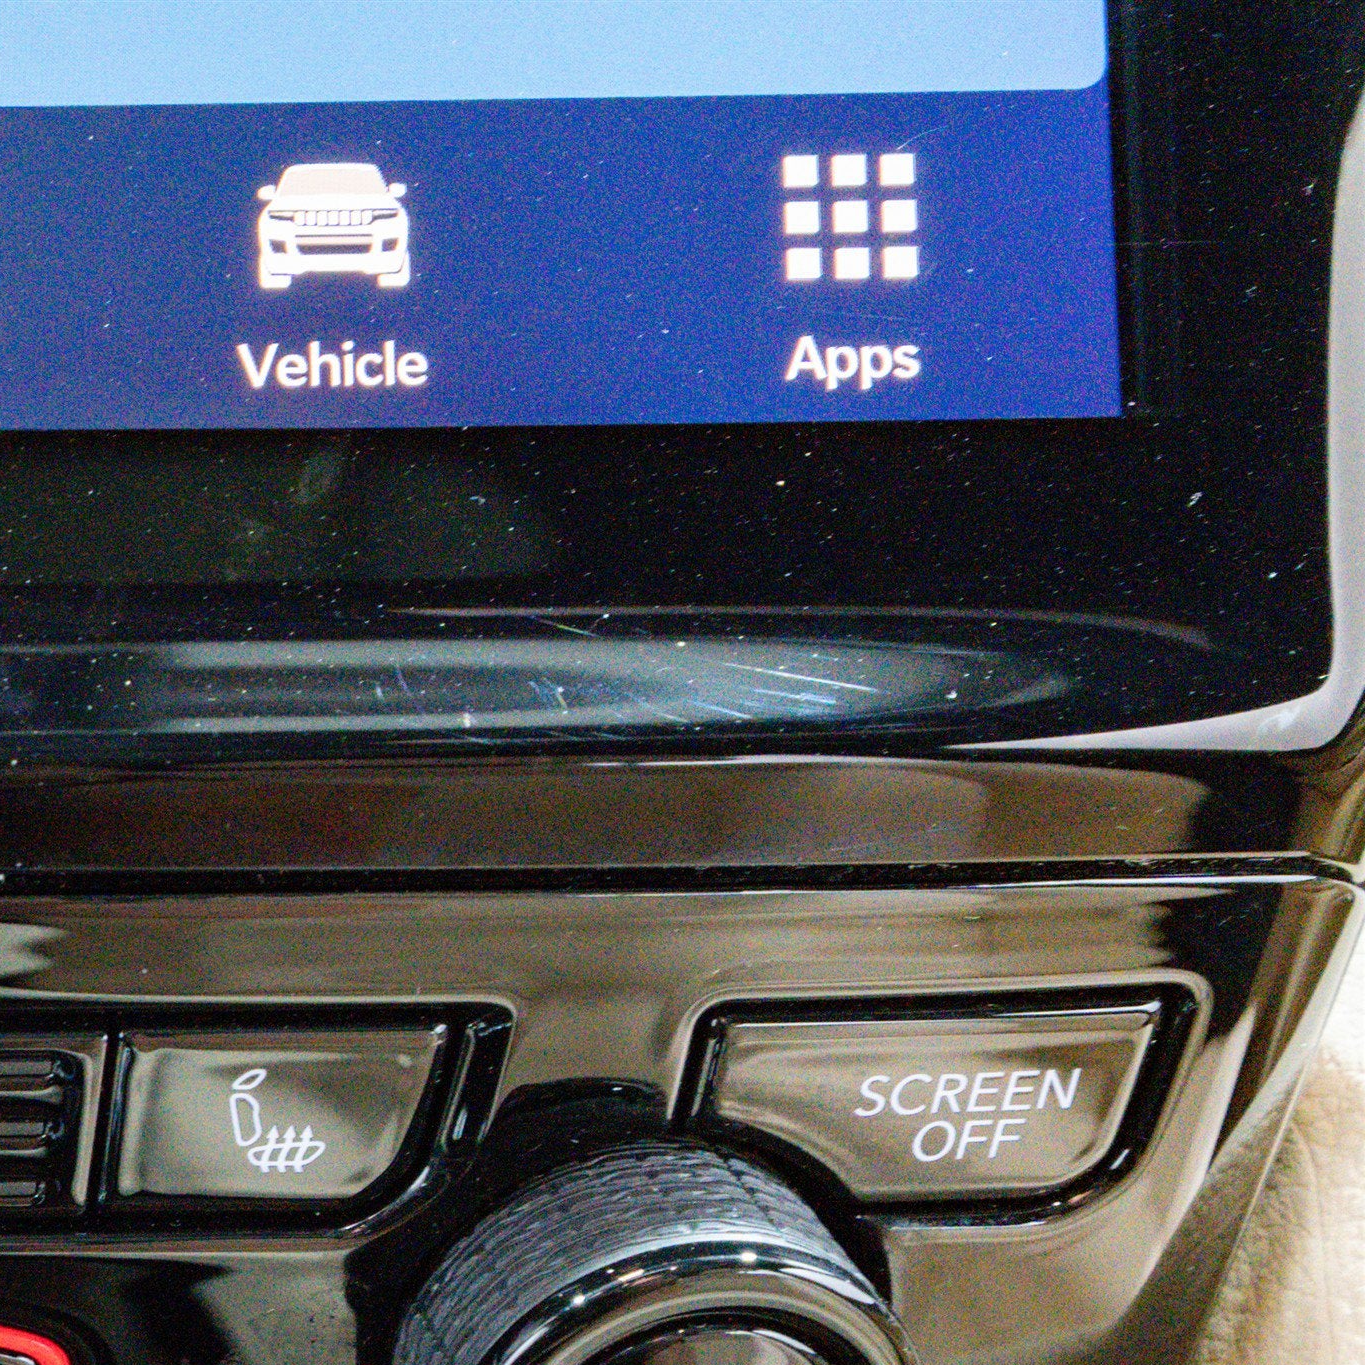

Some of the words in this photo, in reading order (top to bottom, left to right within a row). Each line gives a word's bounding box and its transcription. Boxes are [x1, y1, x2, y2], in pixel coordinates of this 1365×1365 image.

[236, 338, 430, 391] Vehicle
[784, 334, 921, 392] Apps
[855, 1068, 1081, 1117] SCREEN
[912, 1119, 1021, 1162] OFF
